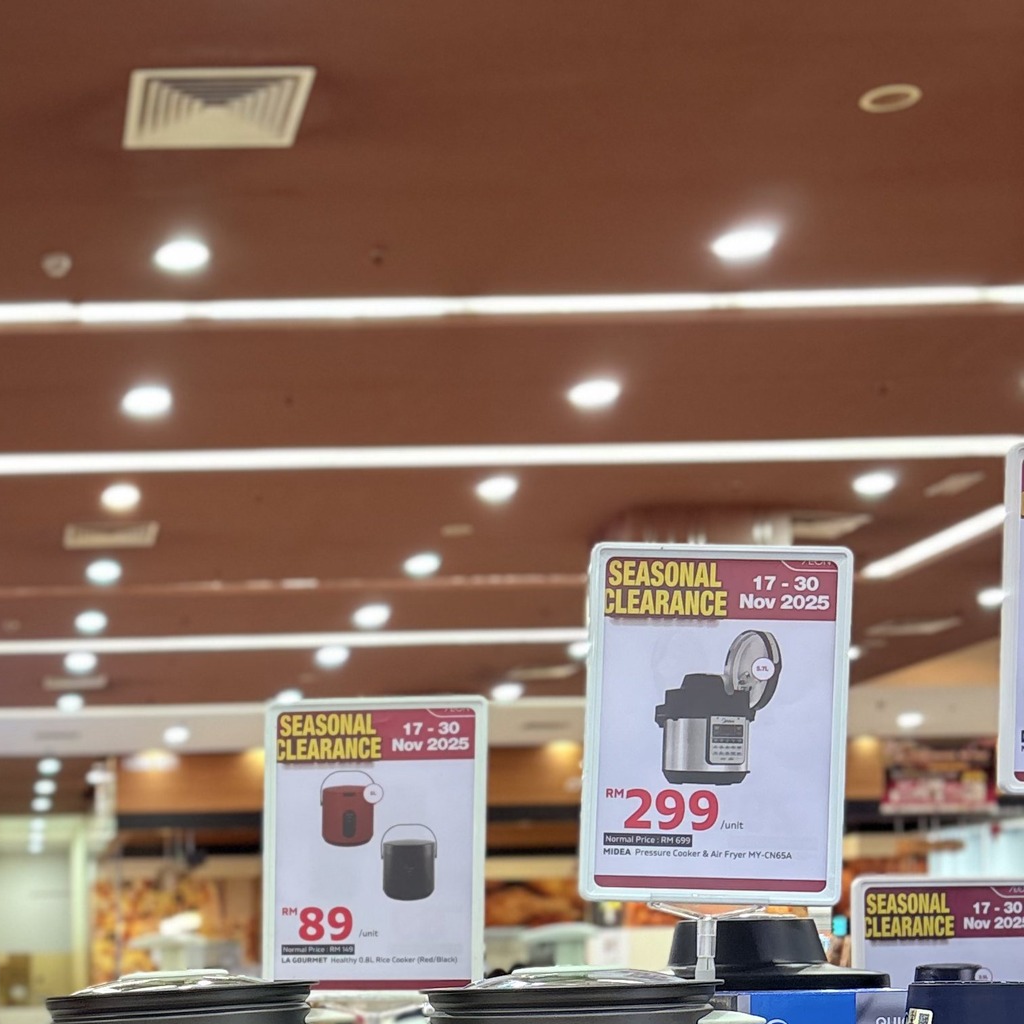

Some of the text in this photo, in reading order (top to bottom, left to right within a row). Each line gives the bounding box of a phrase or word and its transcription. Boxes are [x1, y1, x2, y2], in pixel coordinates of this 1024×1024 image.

[608, 560, 819, 591] SEASONAL 17 30
[604, 588, 830, 617] CLEARANCE Nov 2025
[279, 713, 460, 737] SEASONAL 17 30
[277, 737, 469, 761] CLEARANCE Nov 2025
[605, 788, 624, 799] RM
[624, 788, 719, 831] 299
[605, 835, 691, 845] Normal Price RM 699
[603, 848, 631, 856] MIDEA
[634, 848, 671, 857] Pressure
[672, 849, 700, 858] Cooker
[710, 850, 723, 858] Air
[724, 851, 747, 860] Fryer
[866, 893, 1023, 915] SEASONAL 17 30
[282, 906, 353, 942] RM 89
[865, 915, 1024, 938] CLEARANCE Nov 202
